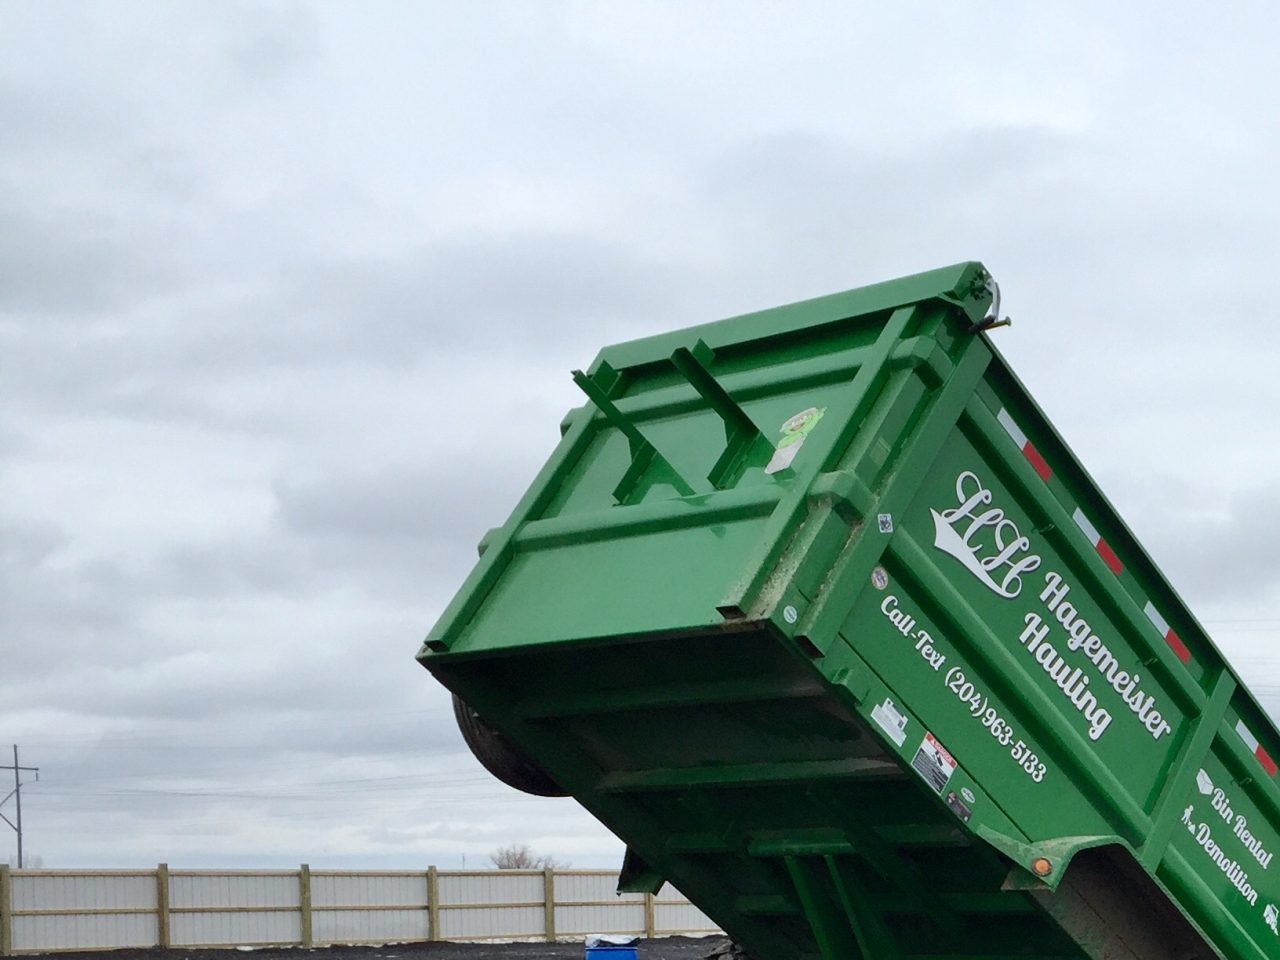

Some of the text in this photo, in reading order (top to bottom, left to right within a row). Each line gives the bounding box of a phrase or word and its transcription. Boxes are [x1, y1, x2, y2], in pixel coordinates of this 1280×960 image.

[881, 595, 946, 671] Call-Text
[945, 666, 1047, 783] (204)963-5133
[1019, 612, 1113, 742] Hauling
[1039, 571, 1171, 740] Hagemeister
[1196, 822, 1259, 907] Demolition
[1211, 787, 1274, 870] Bin Rental
